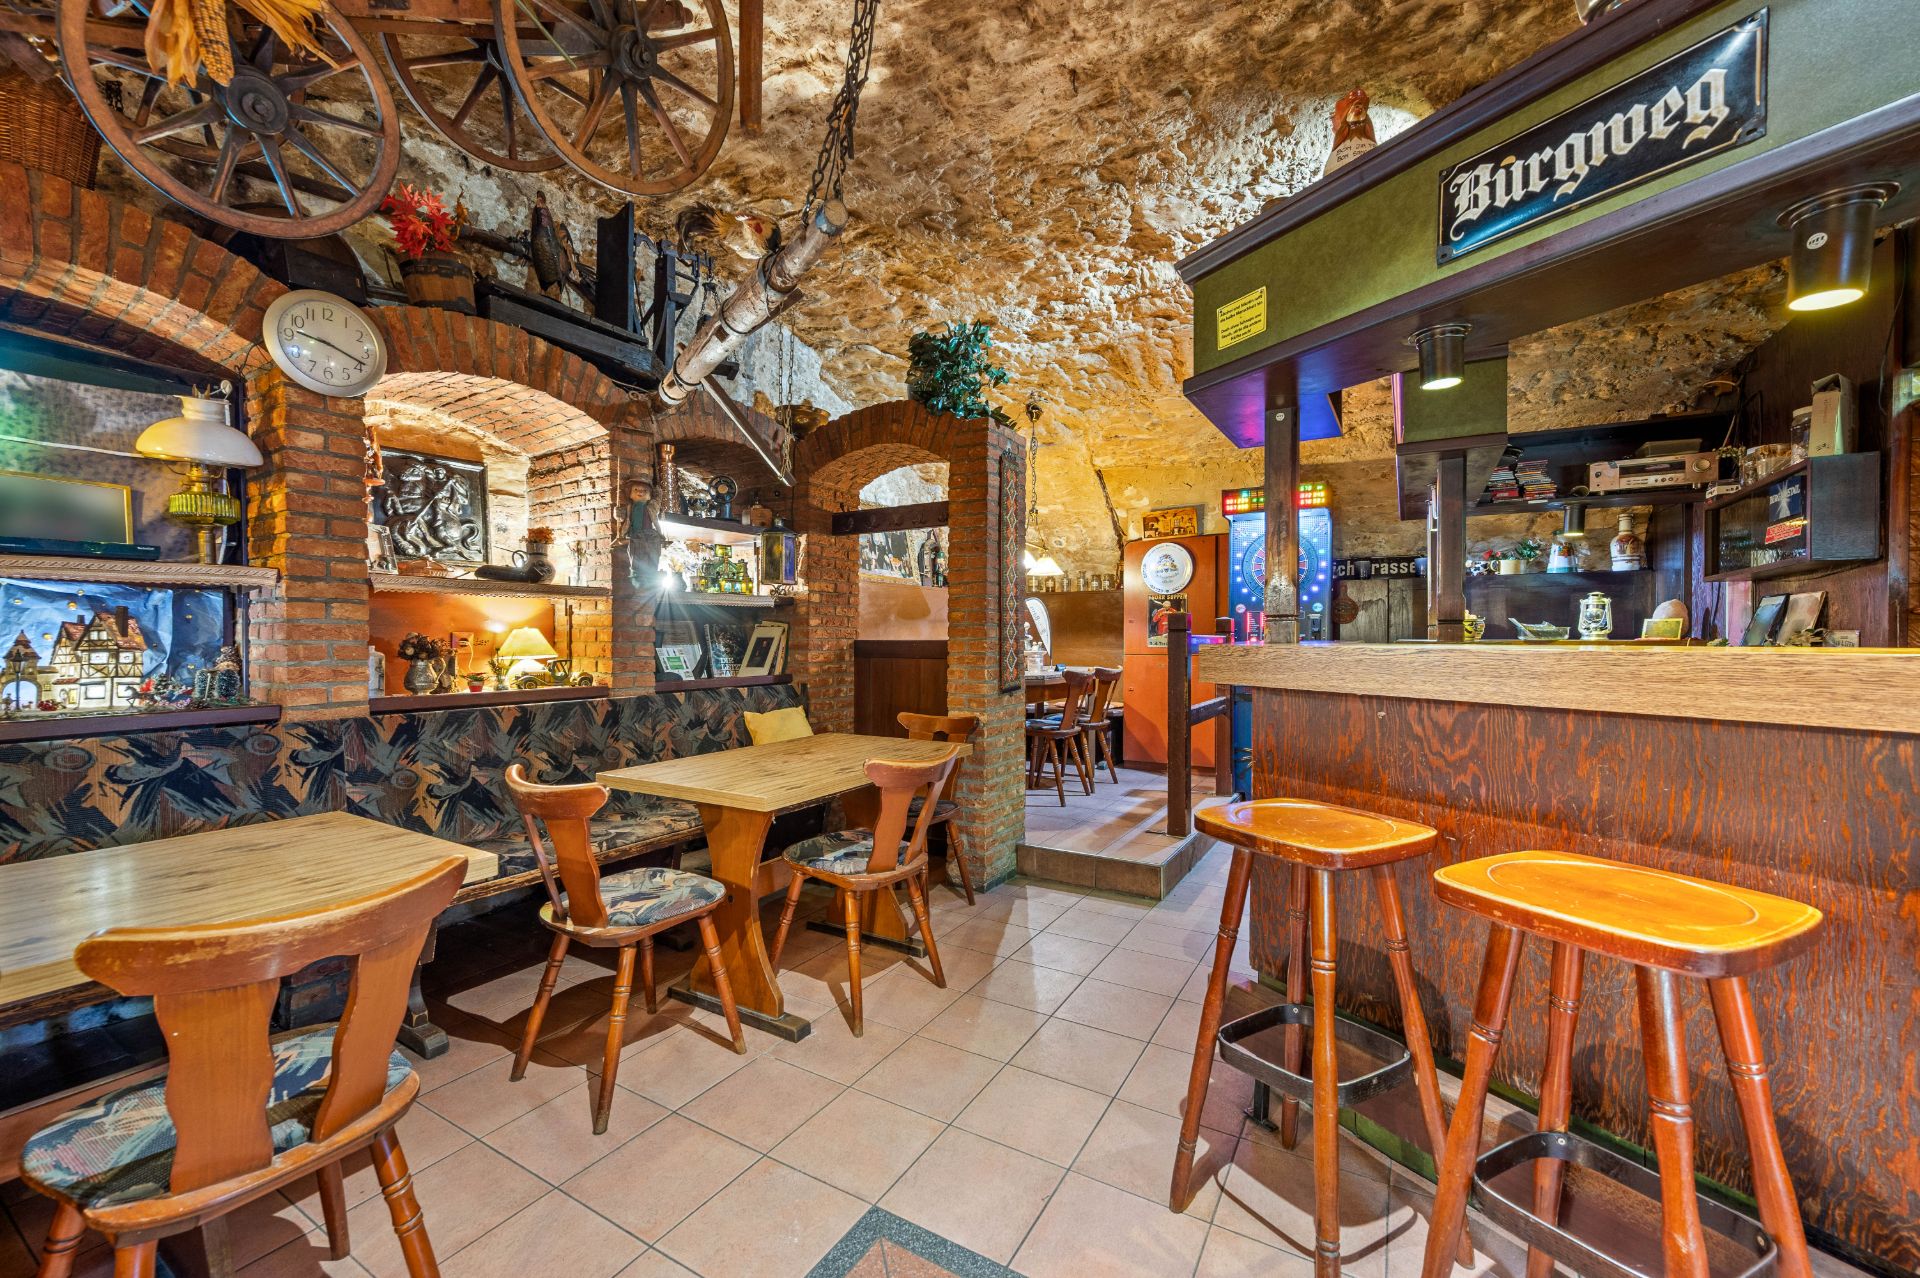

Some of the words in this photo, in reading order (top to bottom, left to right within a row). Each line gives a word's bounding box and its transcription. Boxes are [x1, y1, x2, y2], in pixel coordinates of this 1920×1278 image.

[291, 313, 305, 328] 10
[306, 307, 315, 321] 11
[322, 307, 333, 321] 12
[283, 327, 294, 341] 9
[355, 329, 364, 343] 2
[361, 347, 370, 360] 3
[308, 359, 317, 372] 7
[323, 366, 334, 380] 6
[342, 367, 351, 381] 5
